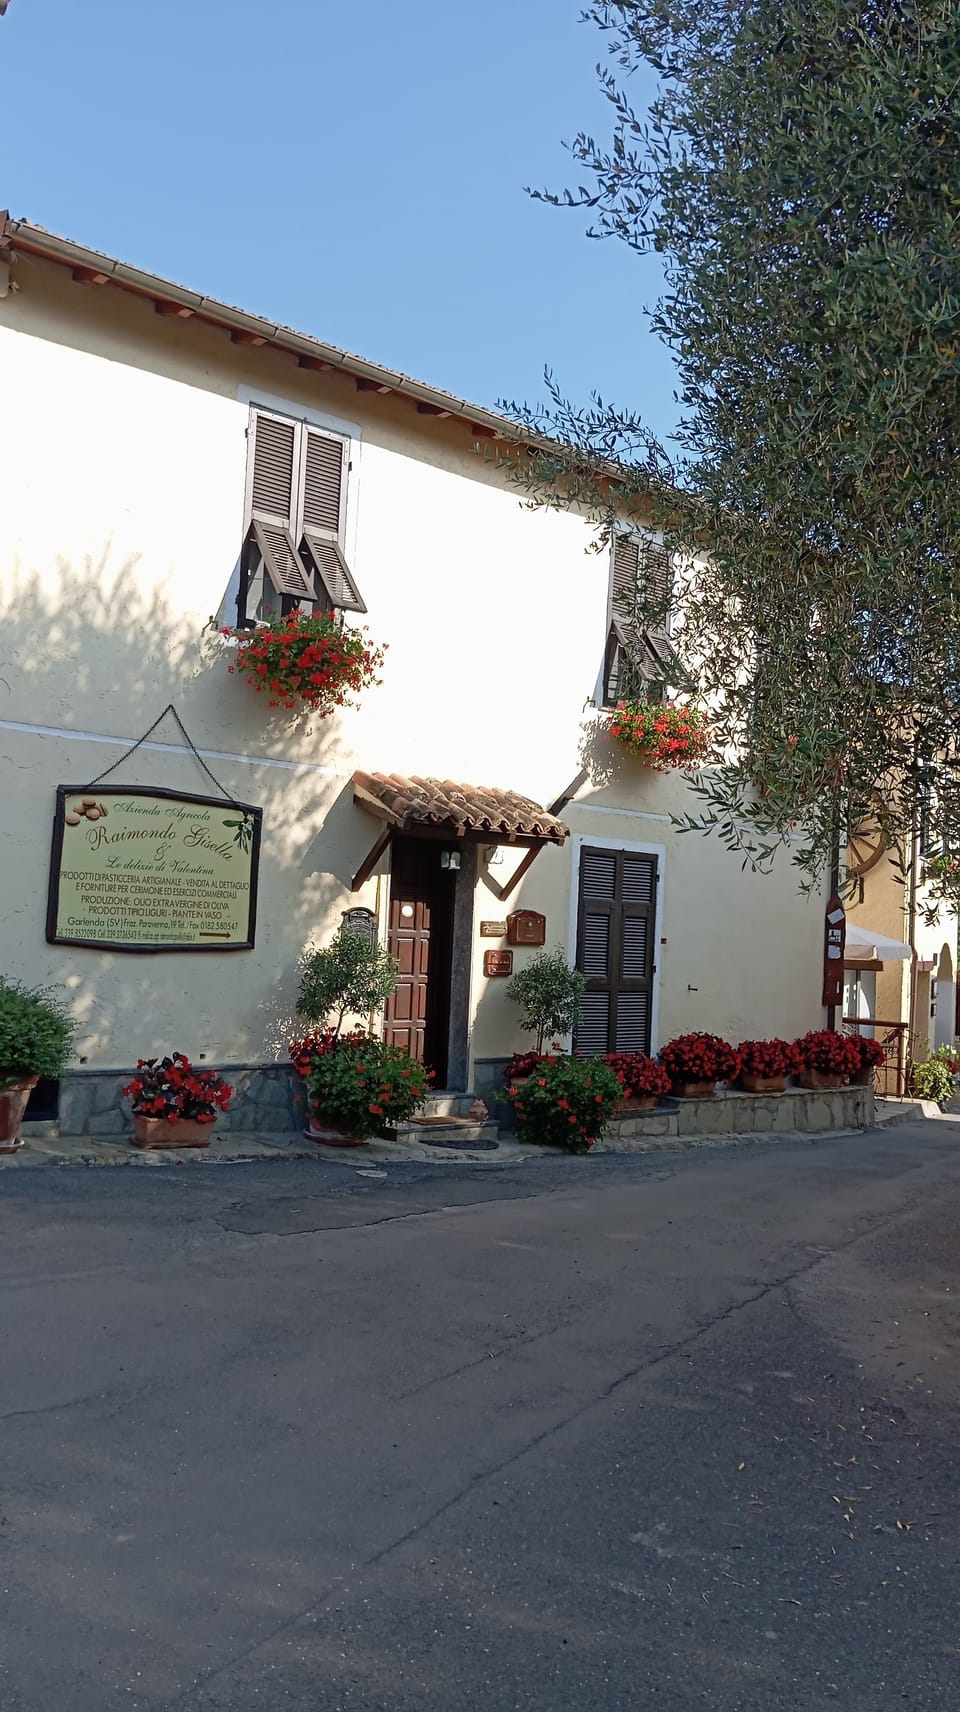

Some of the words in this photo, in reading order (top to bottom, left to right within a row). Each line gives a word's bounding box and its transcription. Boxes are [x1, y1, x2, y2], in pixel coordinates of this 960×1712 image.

[113, 801, 161, 816] Azienda
[165, 806, 211, 822] Agricola
[86, 823, 176, 852] Raimondo
[183, 824, 233, 861] Gisella
[154, 842, 172, 861] &
[105, 856, 121, 869] Le
[123, 858, 153, 871] delizie
[155, 861, 167, 872] di
[170, 860, 214, 875] Valentina
[60, 871, 94, 881] PRODOTTI
[102, 873, 140, 884] PASTICCERIA
[142, 876, 182, 887] ARTIGIANALE
[186, 878, 210, 888] VENDITA
[211, 880, 218, 889] AL
[76, 882, 80, 891] E
[80, 882, 117, 893] FORNITURE
[117, 885, 129, 894] PER
[164, 887, 172, 896] ED
[173, 887, 197, 897] ESERCIZI
[197, 889, 237, 899] COMMERCIALI
[88, 905, 127, 916] PRODOTTI
[145, 908, 167, 918] LIGURI
[172, 910, 195, 919] PIANTE
[196, 911, 203, 919] IN
[204, 911, 222, 920] VASO
[133, 898, 152, 907] OLIO
[153, 898, 175, 908] EXTRA
[174, 900, 202, 909] VERGINE
[203, 901, 210, 910] DI
[211, 902, 230, 911] OLIVA
[67, 916, 105, 927] Garlenda
